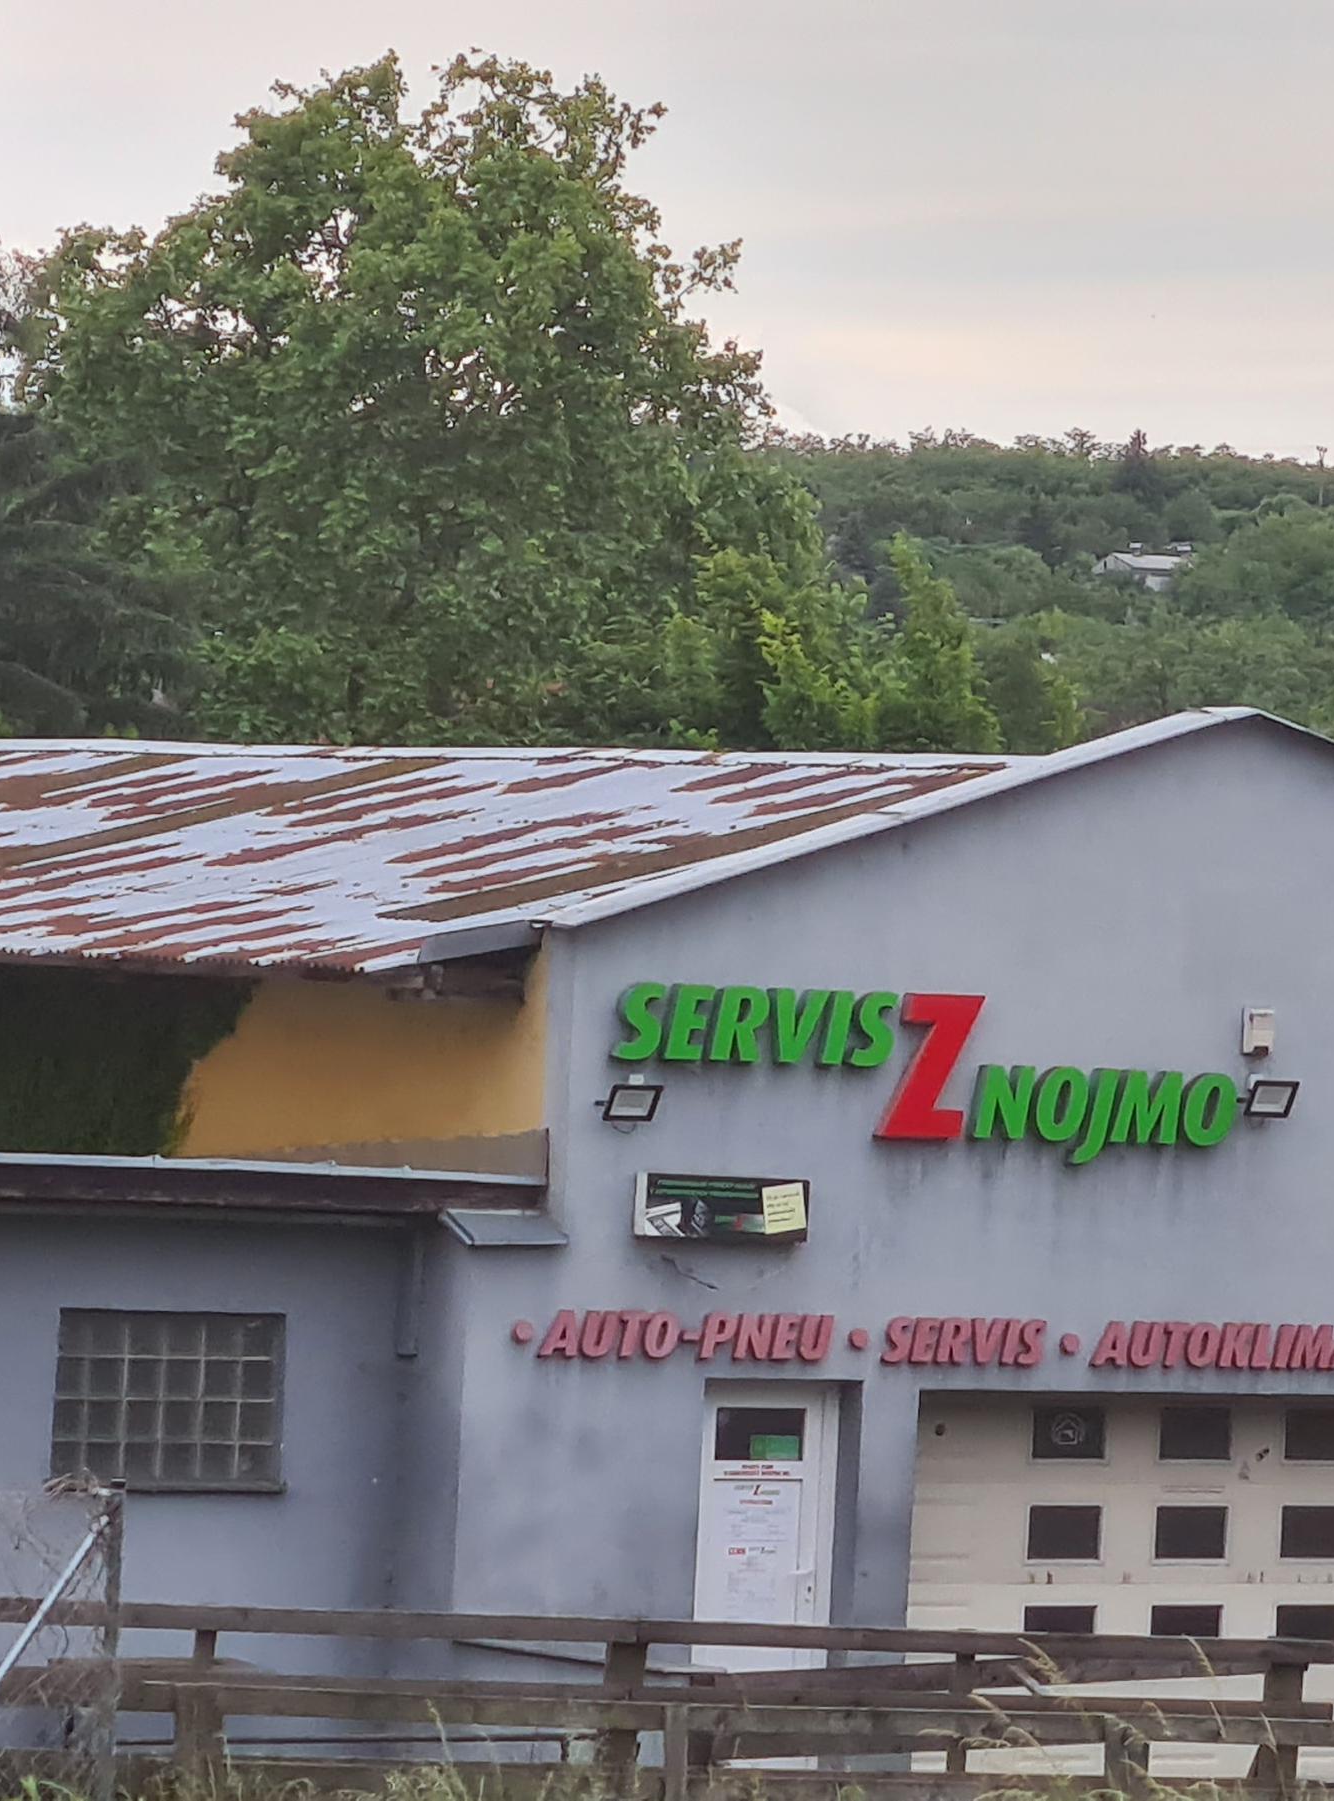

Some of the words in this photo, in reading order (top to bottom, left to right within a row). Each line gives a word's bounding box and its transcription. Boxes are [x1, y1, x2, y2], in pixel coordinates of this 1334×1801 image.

[610, 982, 899, 1068] SERVIS
[536, 1310, 835, 1361] AUTO-PNEU
[880, 1316, 1047, 1367] SERVIS
